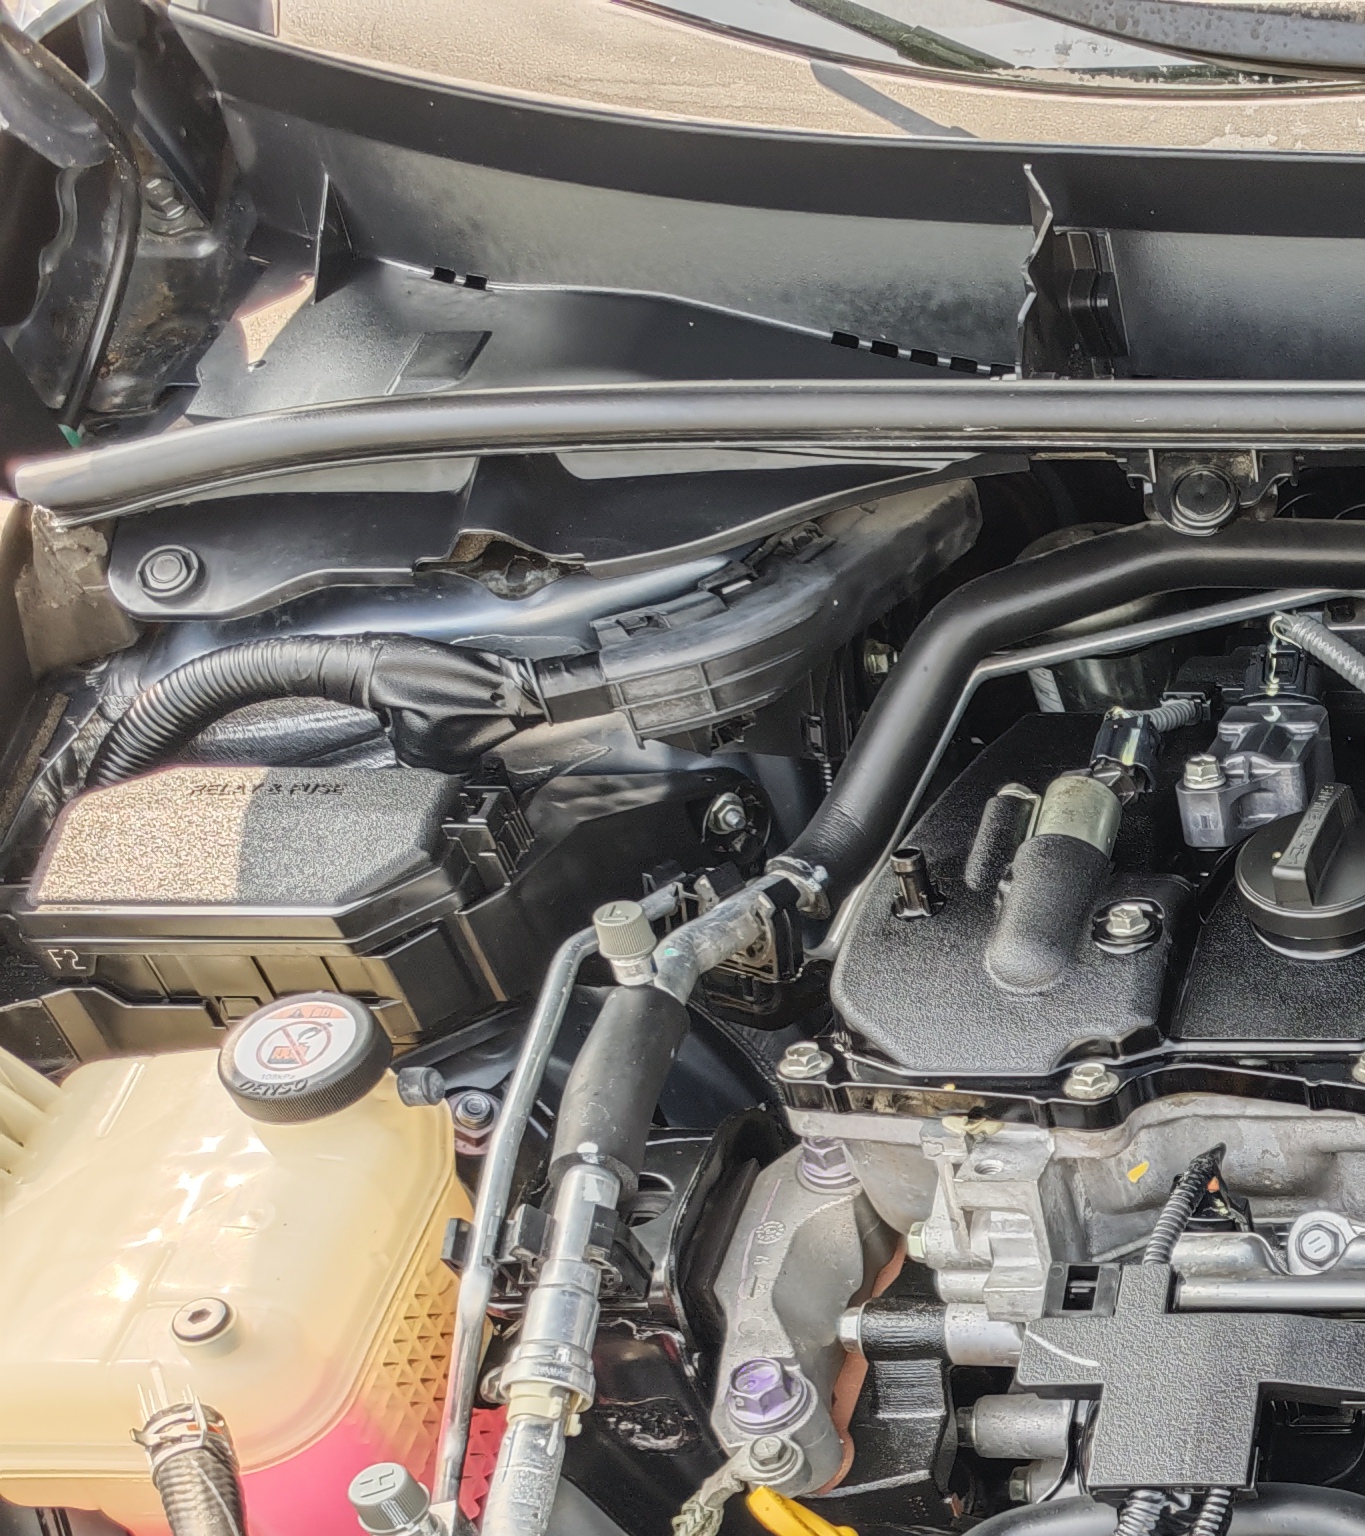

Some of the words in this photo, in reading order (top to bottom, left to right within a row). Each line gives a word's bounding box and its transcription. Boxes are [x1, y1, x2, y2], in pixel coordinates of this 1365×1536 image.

[289, 783, 347, 796] FUSE
[47, 949, 87, 970] F2
[236, 1078, 310, 1097] DENSO
